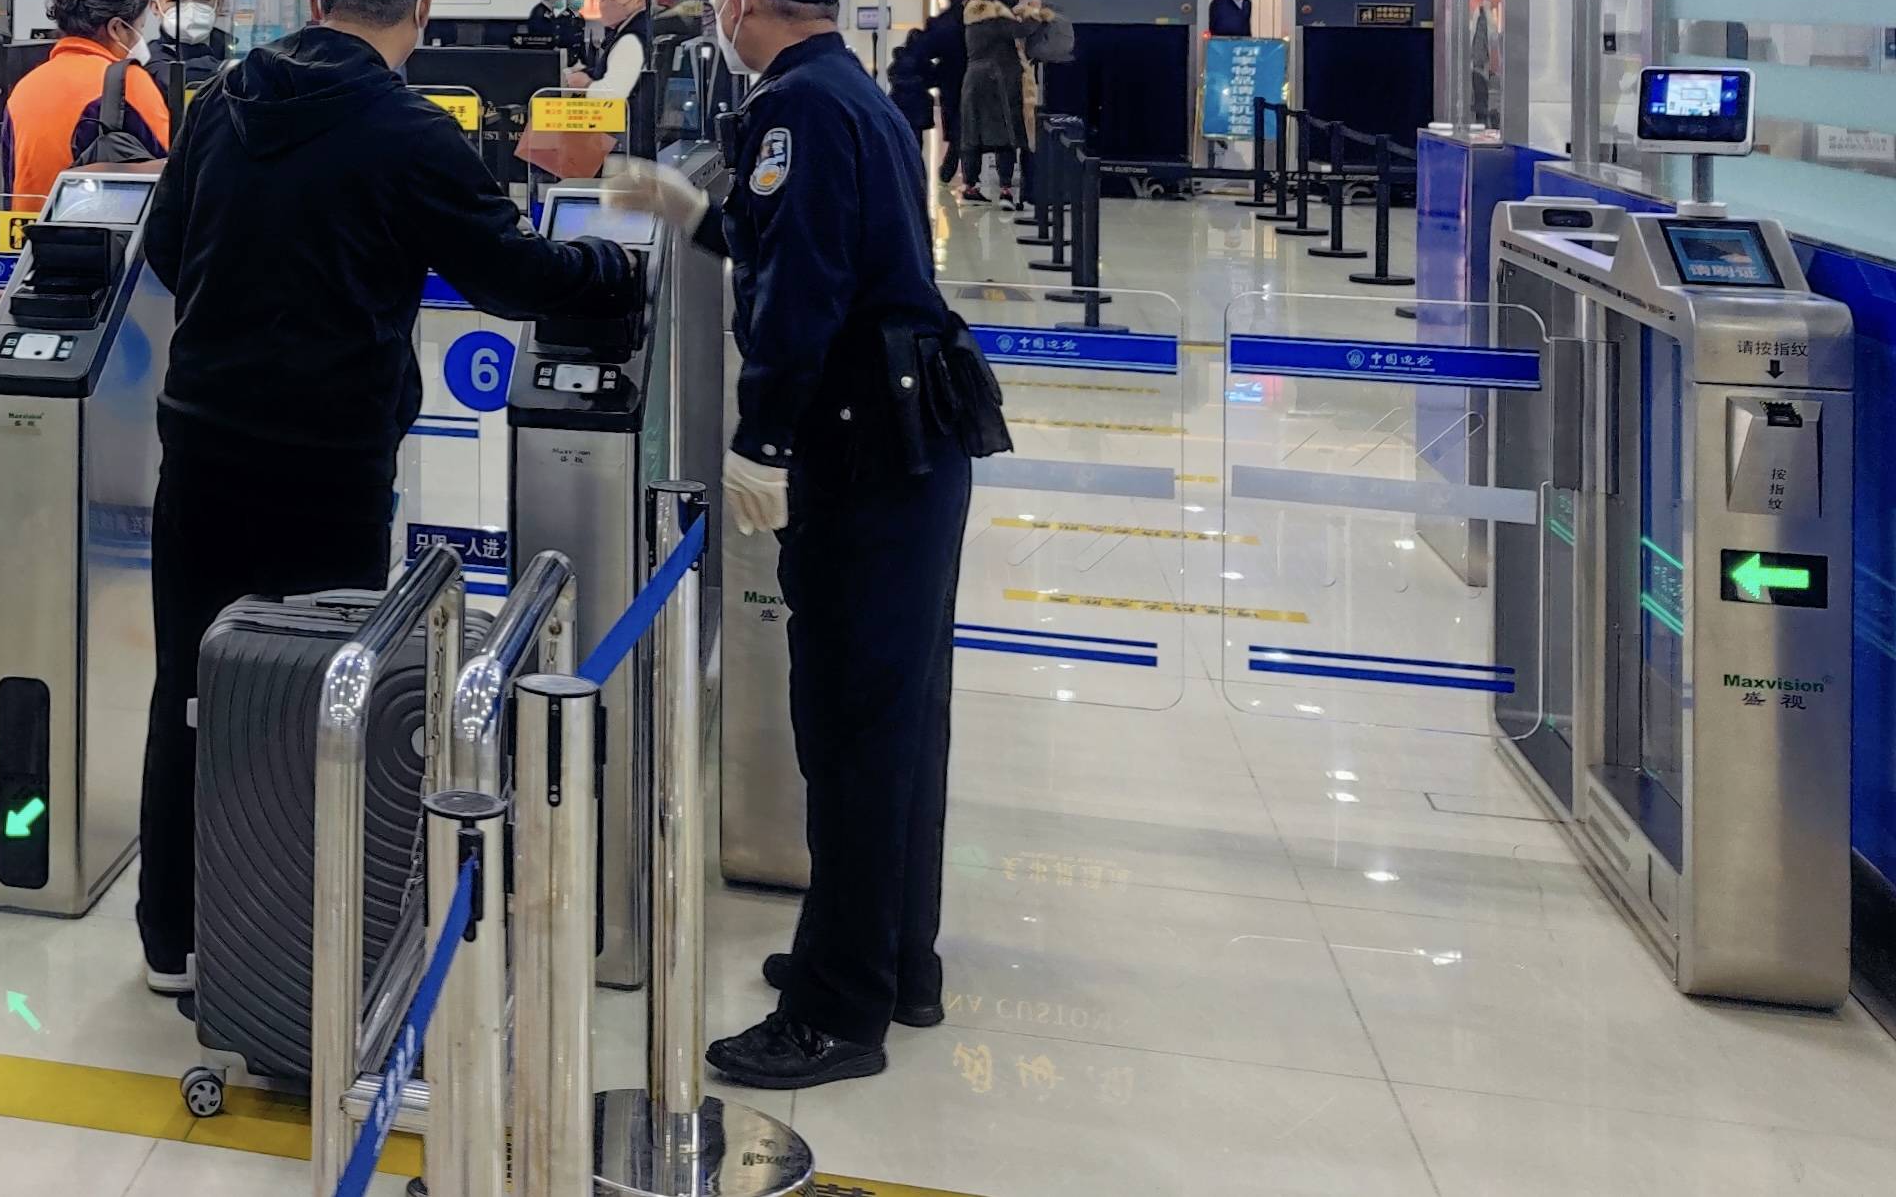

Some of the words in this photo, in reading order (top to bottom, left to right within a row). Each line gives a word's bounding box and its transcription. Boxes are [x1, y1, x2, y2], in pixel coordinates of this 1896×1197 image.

[1737, 340, 1809, 357] 请按指纹
[1370, 352, 1434, 367] 中国边检
[470, 348, 499, 392] 6
[1768, 469, 1787, 510] 按指纹
[1723, 673, 1825, 694] Maxvision
[1741, 693, 1807, 711] 盛视
